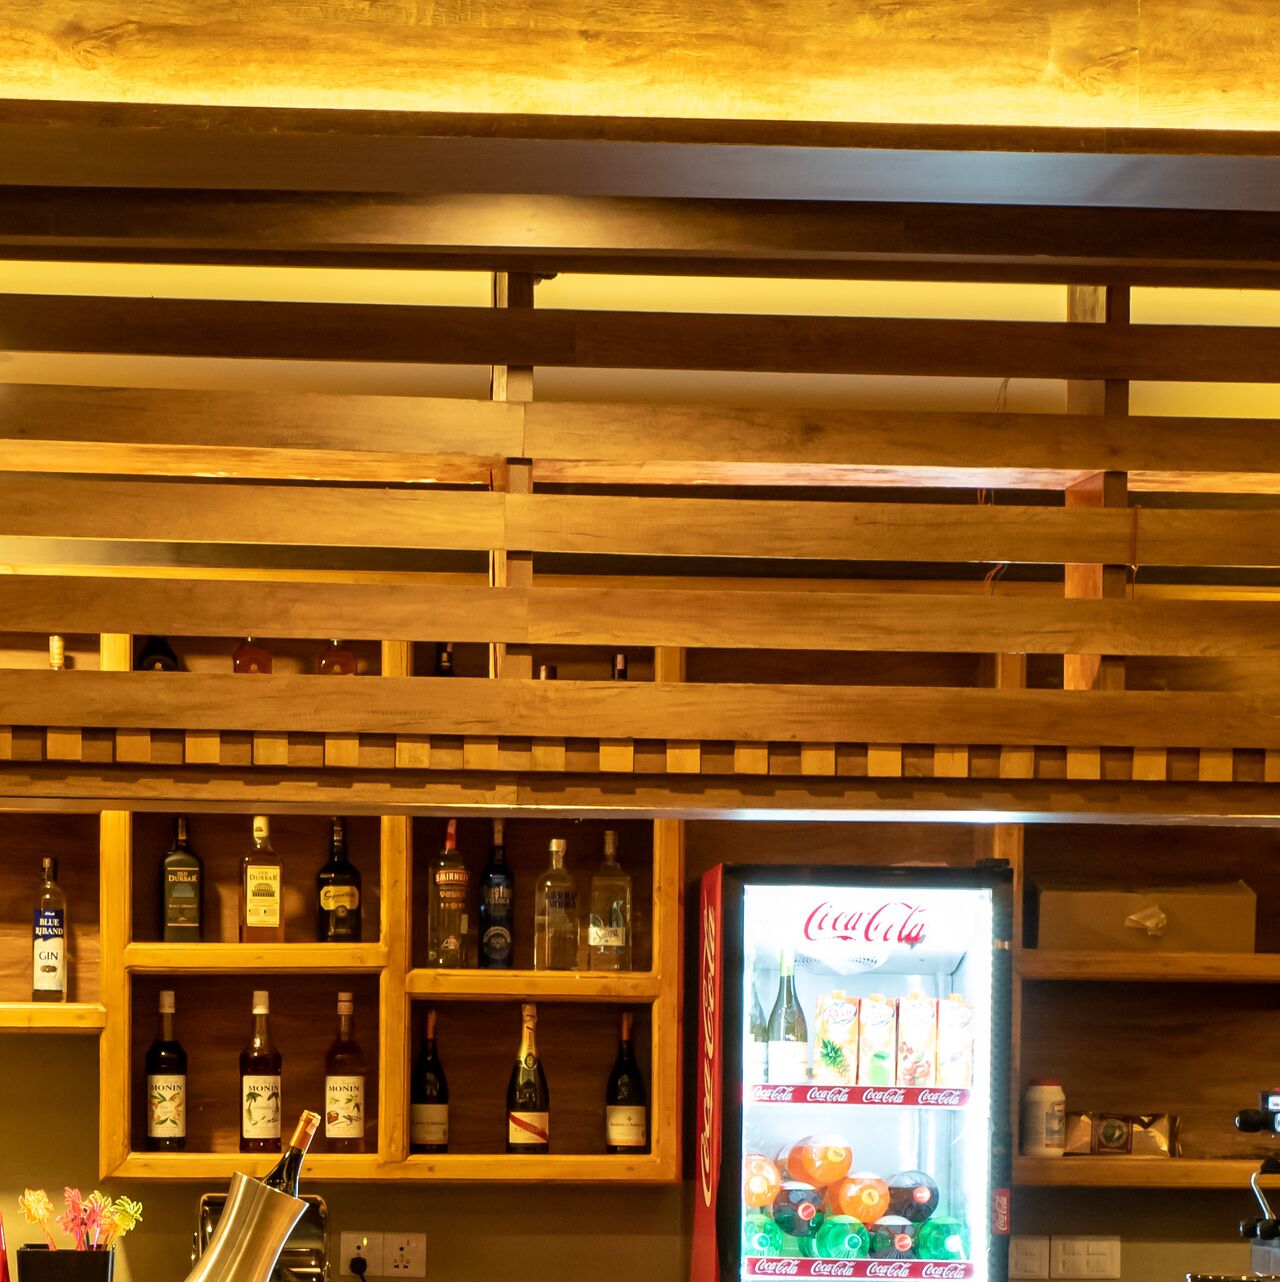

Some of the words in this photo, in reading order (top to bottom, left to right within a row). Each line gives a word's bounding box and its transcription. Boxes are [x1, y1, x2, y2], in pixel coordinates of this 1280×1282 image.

[168, 874, 198, 882] DURBAR
[249, 873, 278, 881] DURBAR
[39, 917, 60, 926] BLUE
[35, 926, 64, 936] RIBAND
[38, 951, 59, 961] GIN
[150, 1084, 183, 1092] MONIN
[248, 1084, 280, 1092] MONIN
